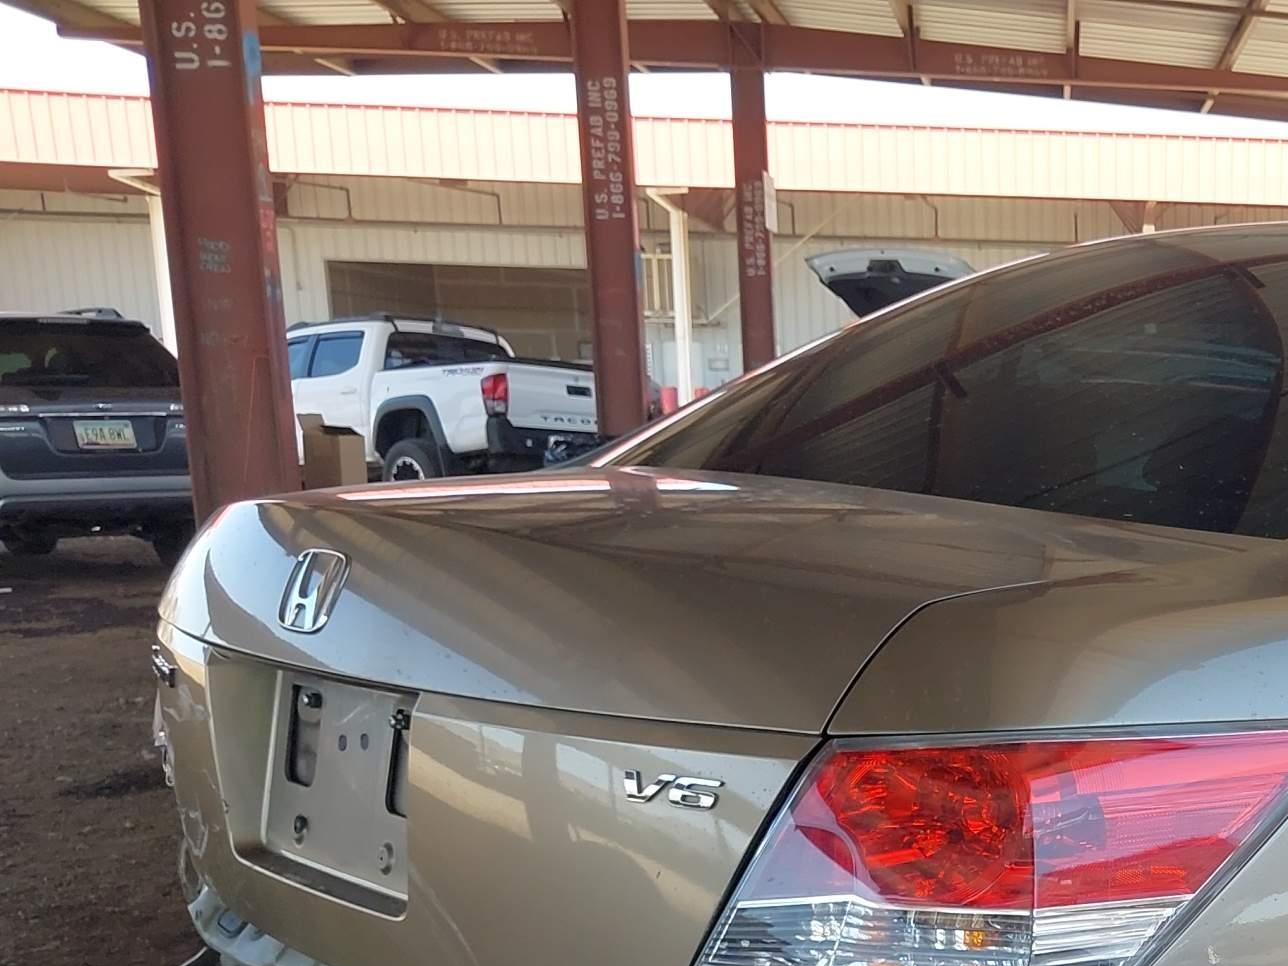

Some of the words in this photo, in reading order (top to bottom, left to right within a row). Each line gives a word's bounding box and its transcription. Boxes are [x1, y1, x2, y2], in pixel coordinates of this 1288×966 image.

[171, 11, 200, 70] U.S.
[587, 80, 602, 109] INC
[589, 115, 606, 180] PREFAB
[602, 77, 625, 219] 1-866-799-0969
[541, 415, 599, 425] TACO
[623, 769, 726, 811] V6
